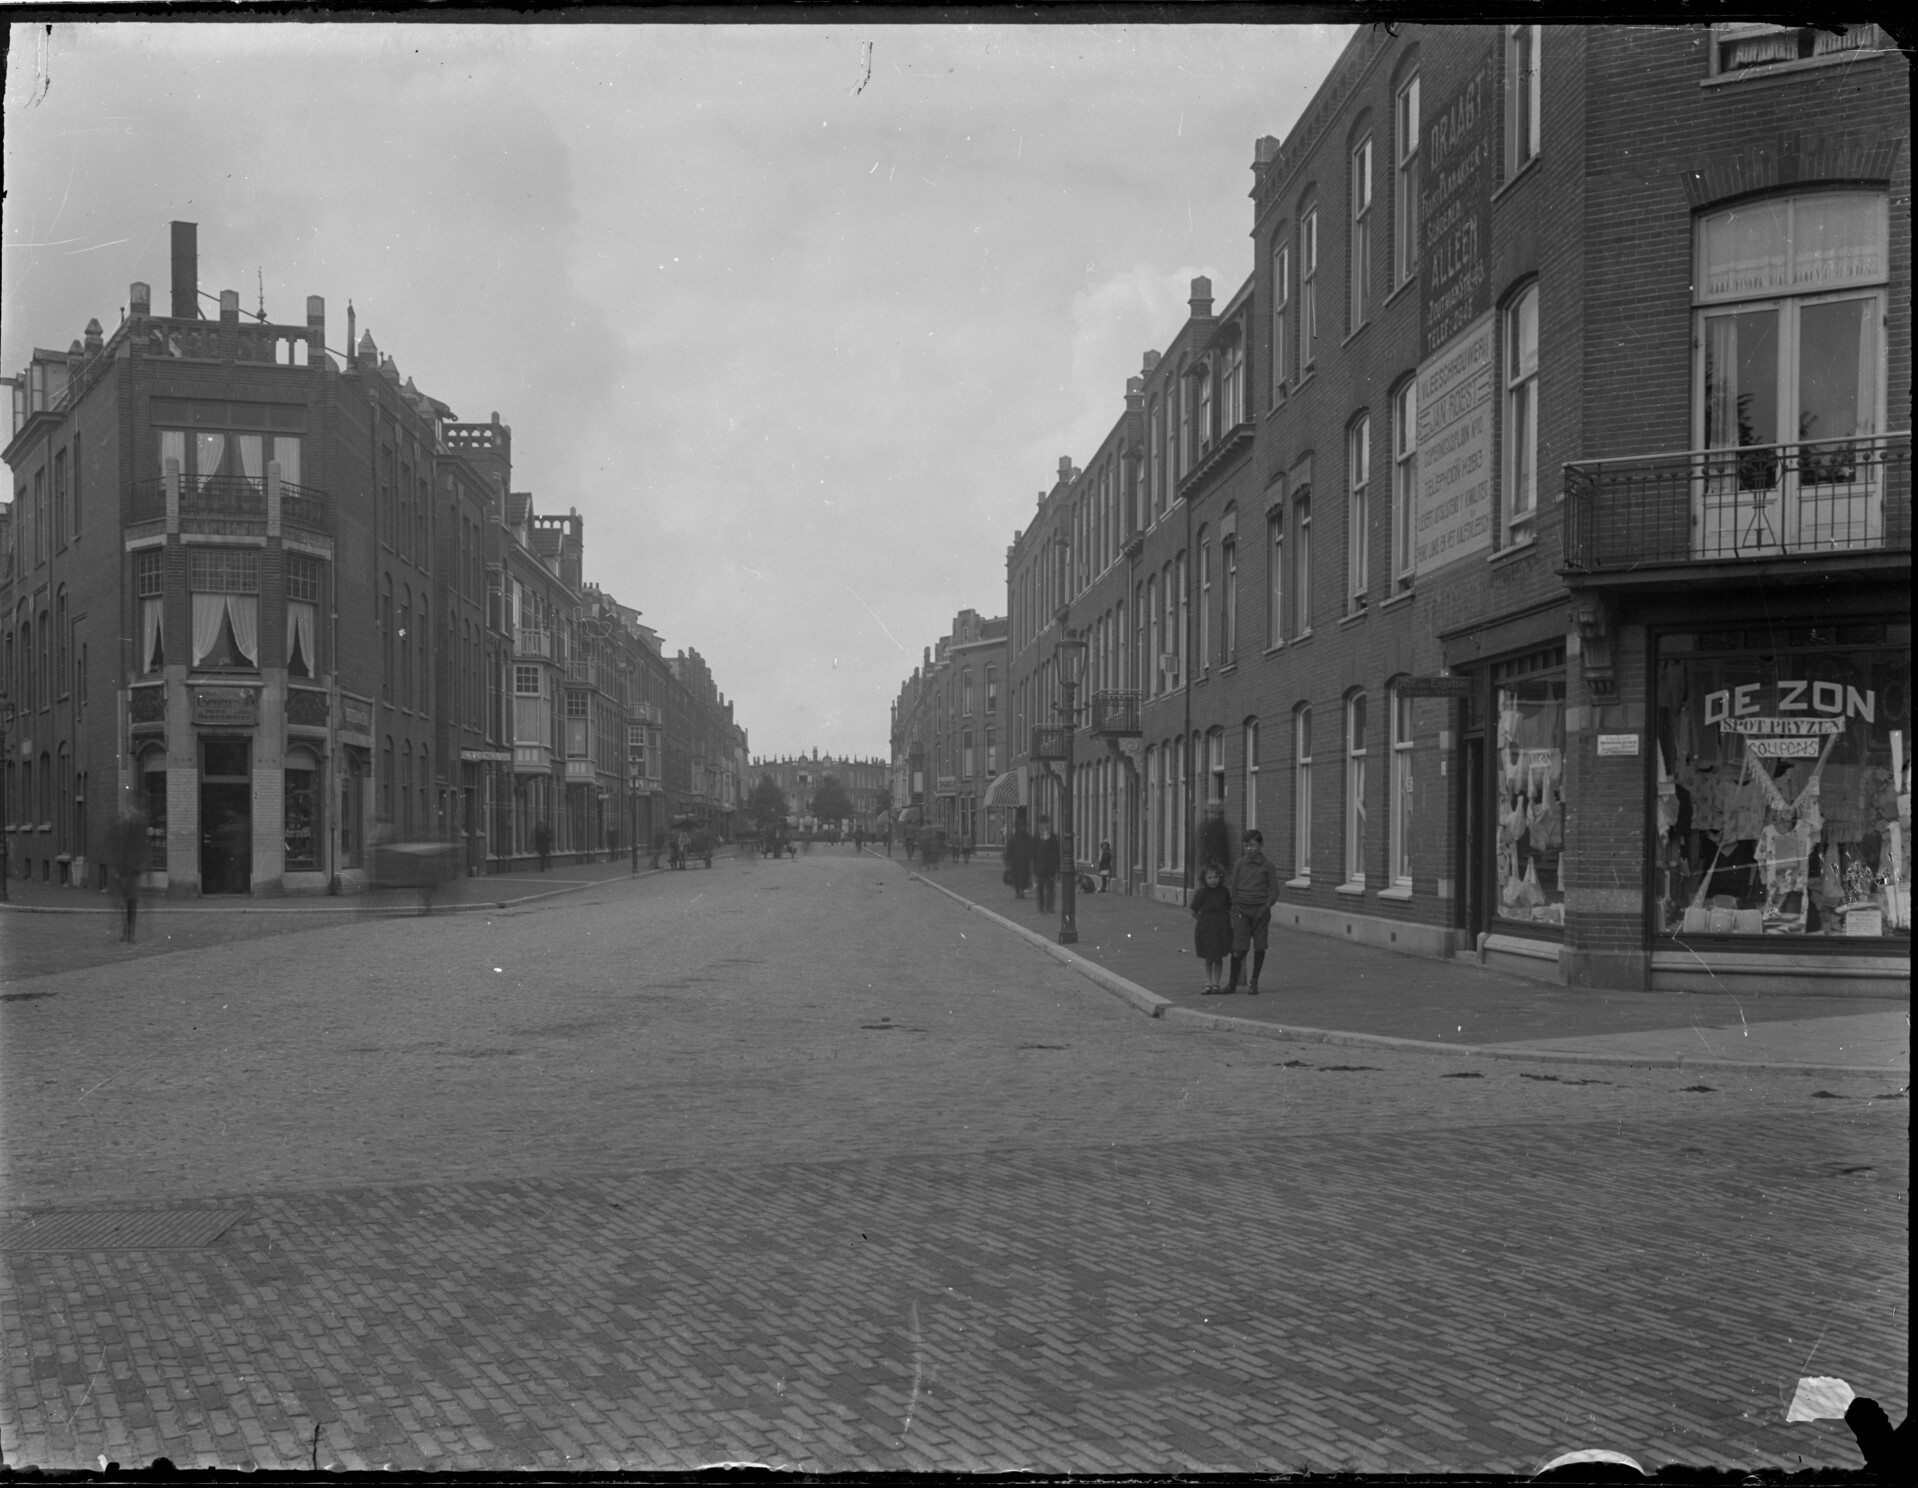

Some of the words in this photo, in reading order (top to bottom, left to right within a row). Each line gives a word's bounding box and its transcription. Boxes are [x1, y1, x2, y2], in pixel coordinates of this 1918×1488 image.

[1431, 69, 1486, 173] DRAAGT
[1431, 214, 1477, 294] ALLEEN
[1430, 398, 1447, 430] JAN
[1449, 377, 1478, 420] ROEST
[1423, 458, 1461, 499] TELEPHOON
[1704, 682, 1761, 726] DE
[1777, 680, 1876, 723] ZON
[1749, 741, 1819, 757] COUPONS
